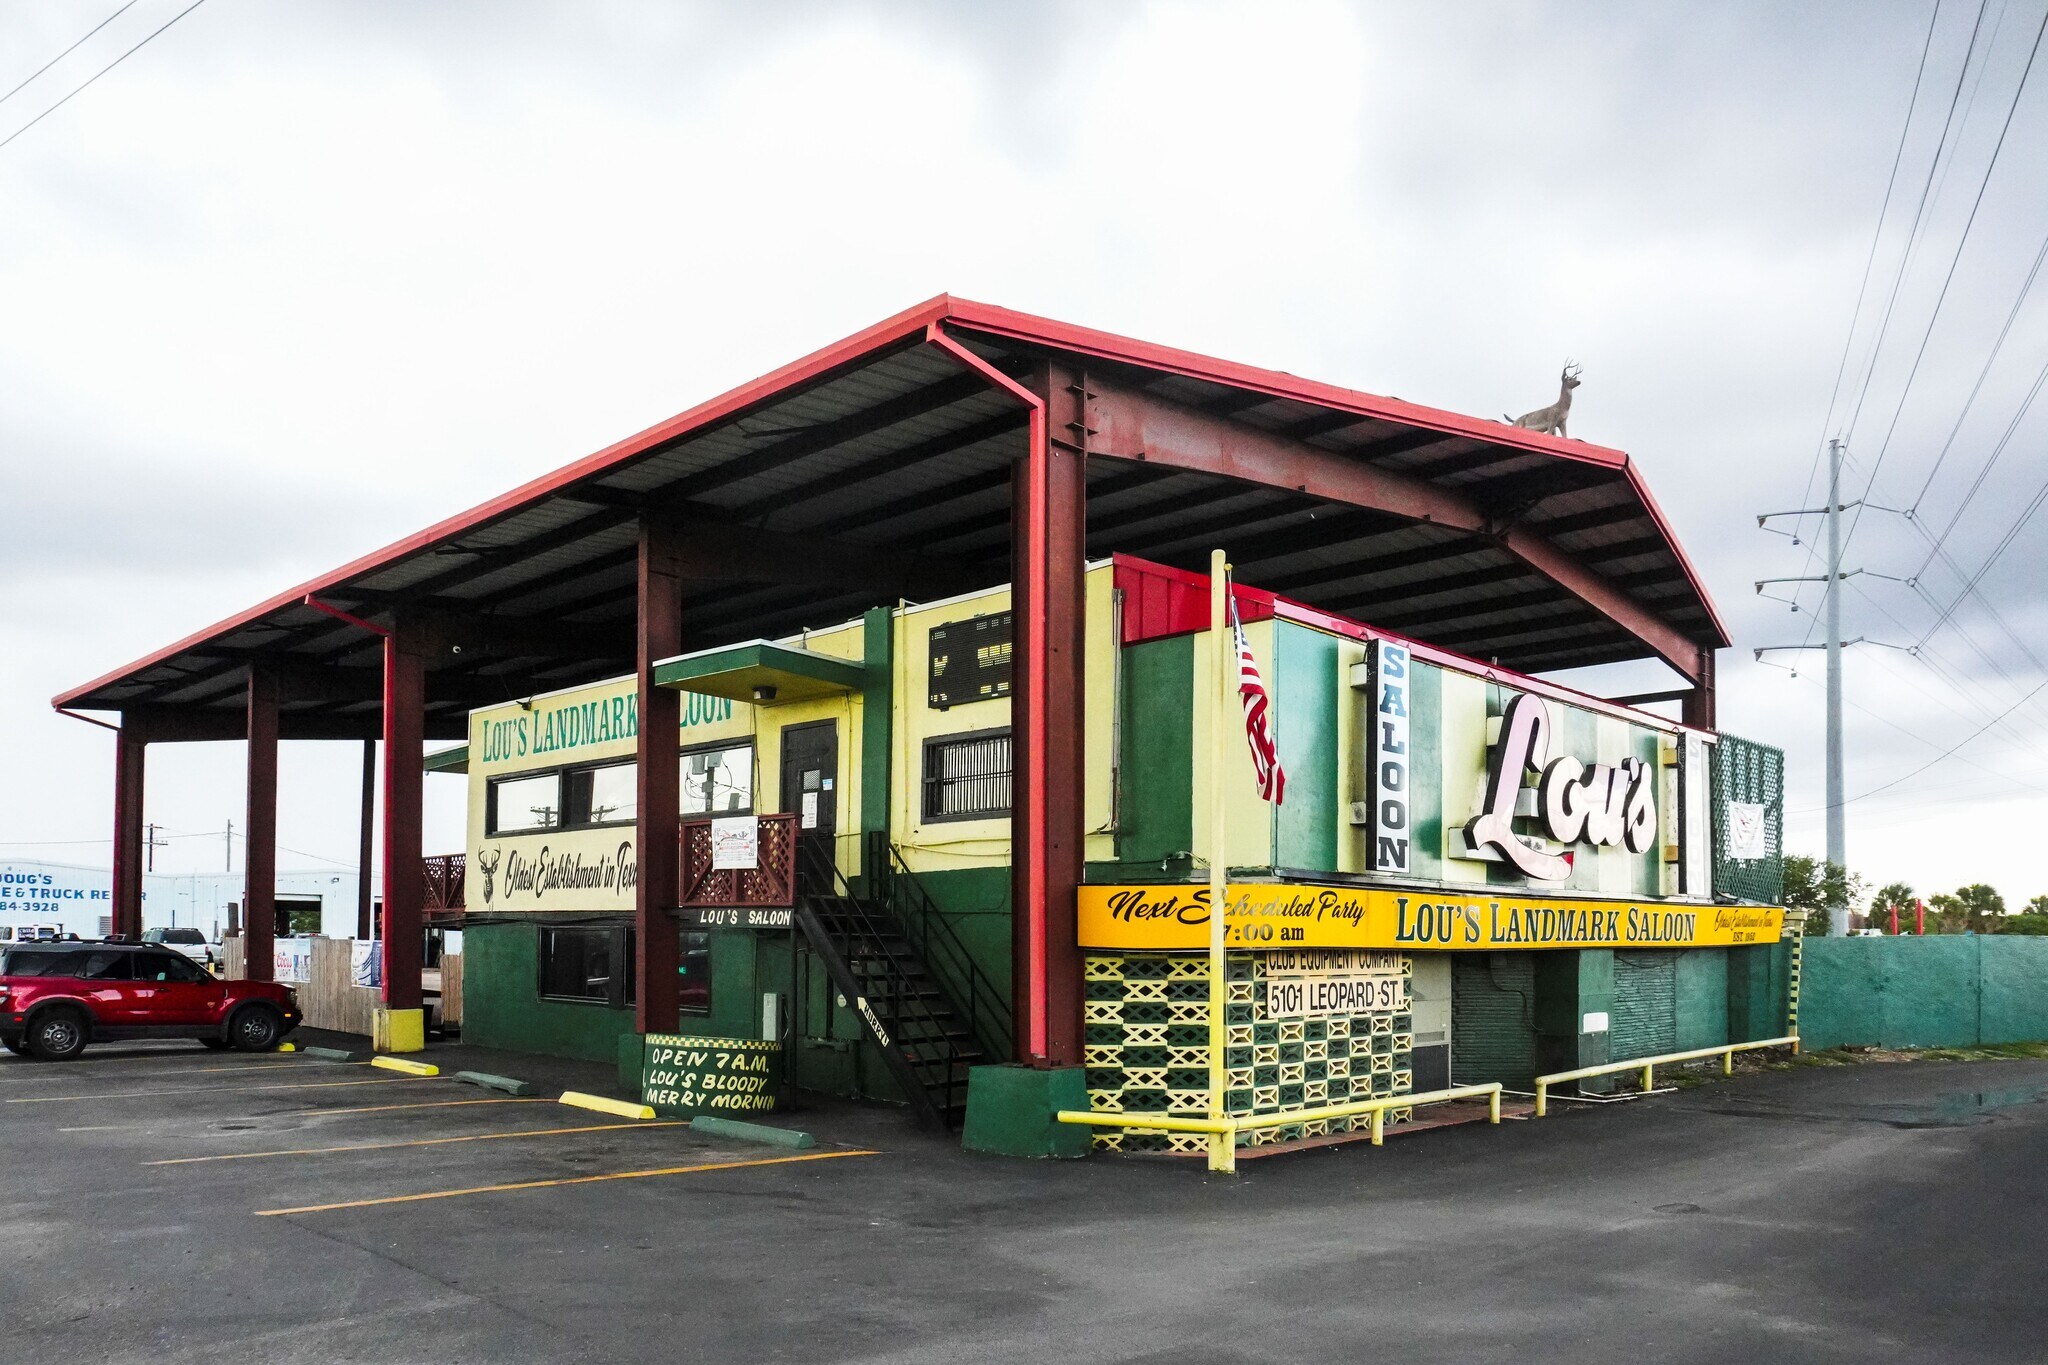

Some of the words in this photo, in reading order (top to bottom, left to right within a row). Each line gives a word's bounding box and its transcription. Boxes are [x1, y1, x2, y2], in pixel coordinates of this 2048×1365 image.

[482, 716, 527, 762] LOU'S
[533, 693, 638, 754] LANDMARK
[1379, 646, 1408, 868] SALOON
[1464, 694, 1656, 881] Lou's
[0, 873, 52, 885] OUG'S
[504, 850, 537, 899] Oldest
[535, 845, 605, 899] Establishment
[604, 857, 616, 888] in
[617, 841, 637, 896] Texa
[29, 888, 84, 899] TRUCK
[700, 909, 738, 924] LOU'S
[748, 910, 791, 925] SALOON
[1107, 890, 1178, 922] Next
[1317, 890, 1366, 927] Party
[1396, 898, 1480, 943] LOU'S
[1490, 903, 1620, 943] LANDMARK
[1626, 908, 1696, 942] SALOON
[1280, 927, 1304, 941] am
[1268, 949, 1295, 970] CLUB
[1300, 949, 1354, 970] EQUIPMENT
[1358, 949, 1399, 969] COMPANY
[1271, 984, 1303, 1013] 5101
[1310, 981, 1375, 1010] LEOPARD
[652, 1048, 708, 1067] OPEN
[649, 1069, 696, 1088] LOU'S
[702, 1074, 767, 1093] BLOODY
[646, 1087, 707, 1107] MERRY
